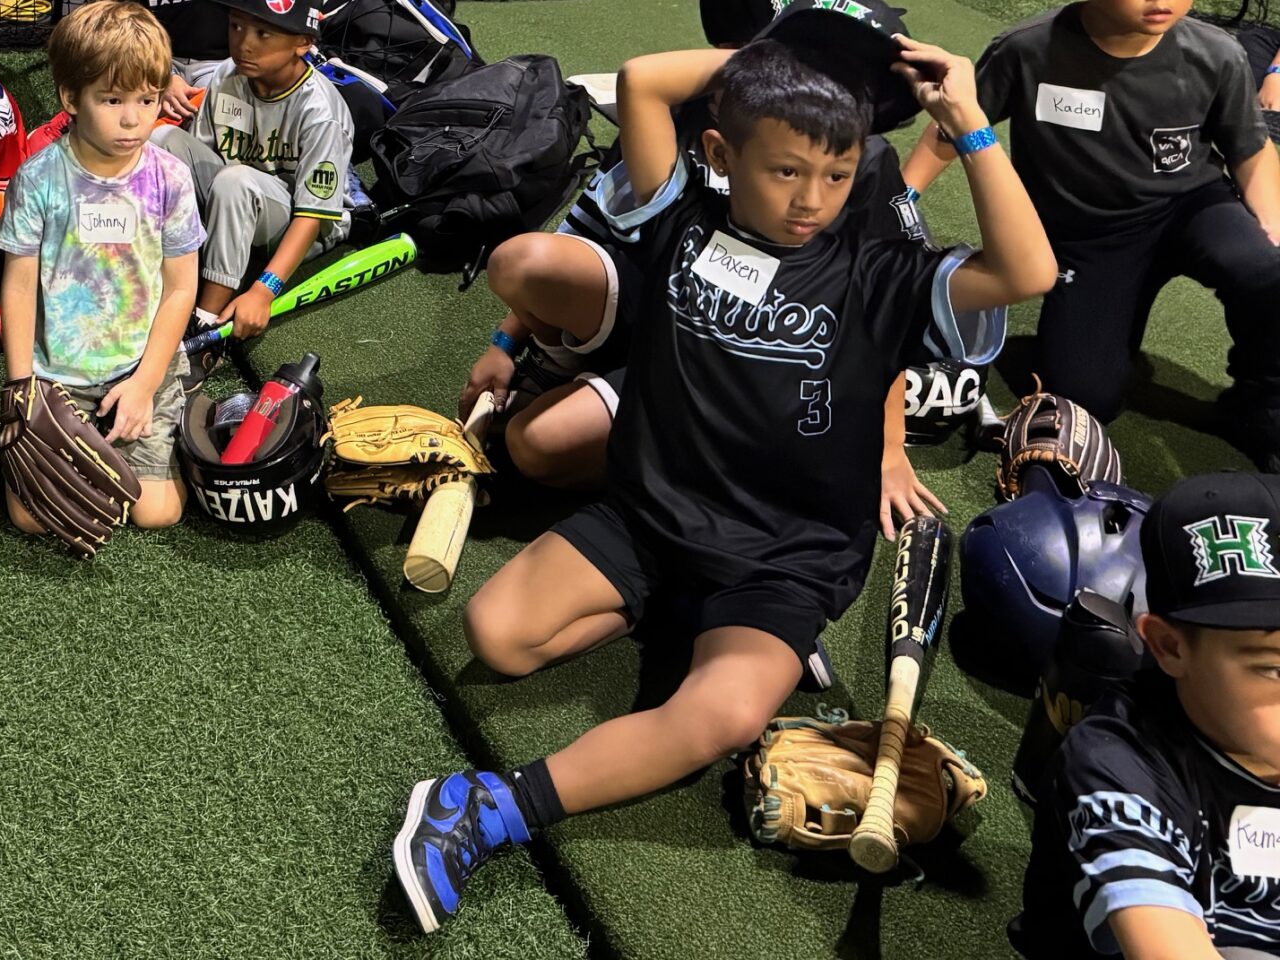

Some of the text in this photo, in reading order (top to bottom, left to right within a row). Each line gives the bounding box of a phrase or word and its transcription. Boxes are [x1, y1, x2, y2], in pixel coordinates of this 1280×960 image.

[1052, 97, 1101, 119] Kaden
[81, 212, 127, 235] Johnny
[294, 251, 410, 310] EASTON
[708, 242, 760, 284] Daxen
[797, 378, 832, 436] 3
[1182, 514, 1280, 587] H
